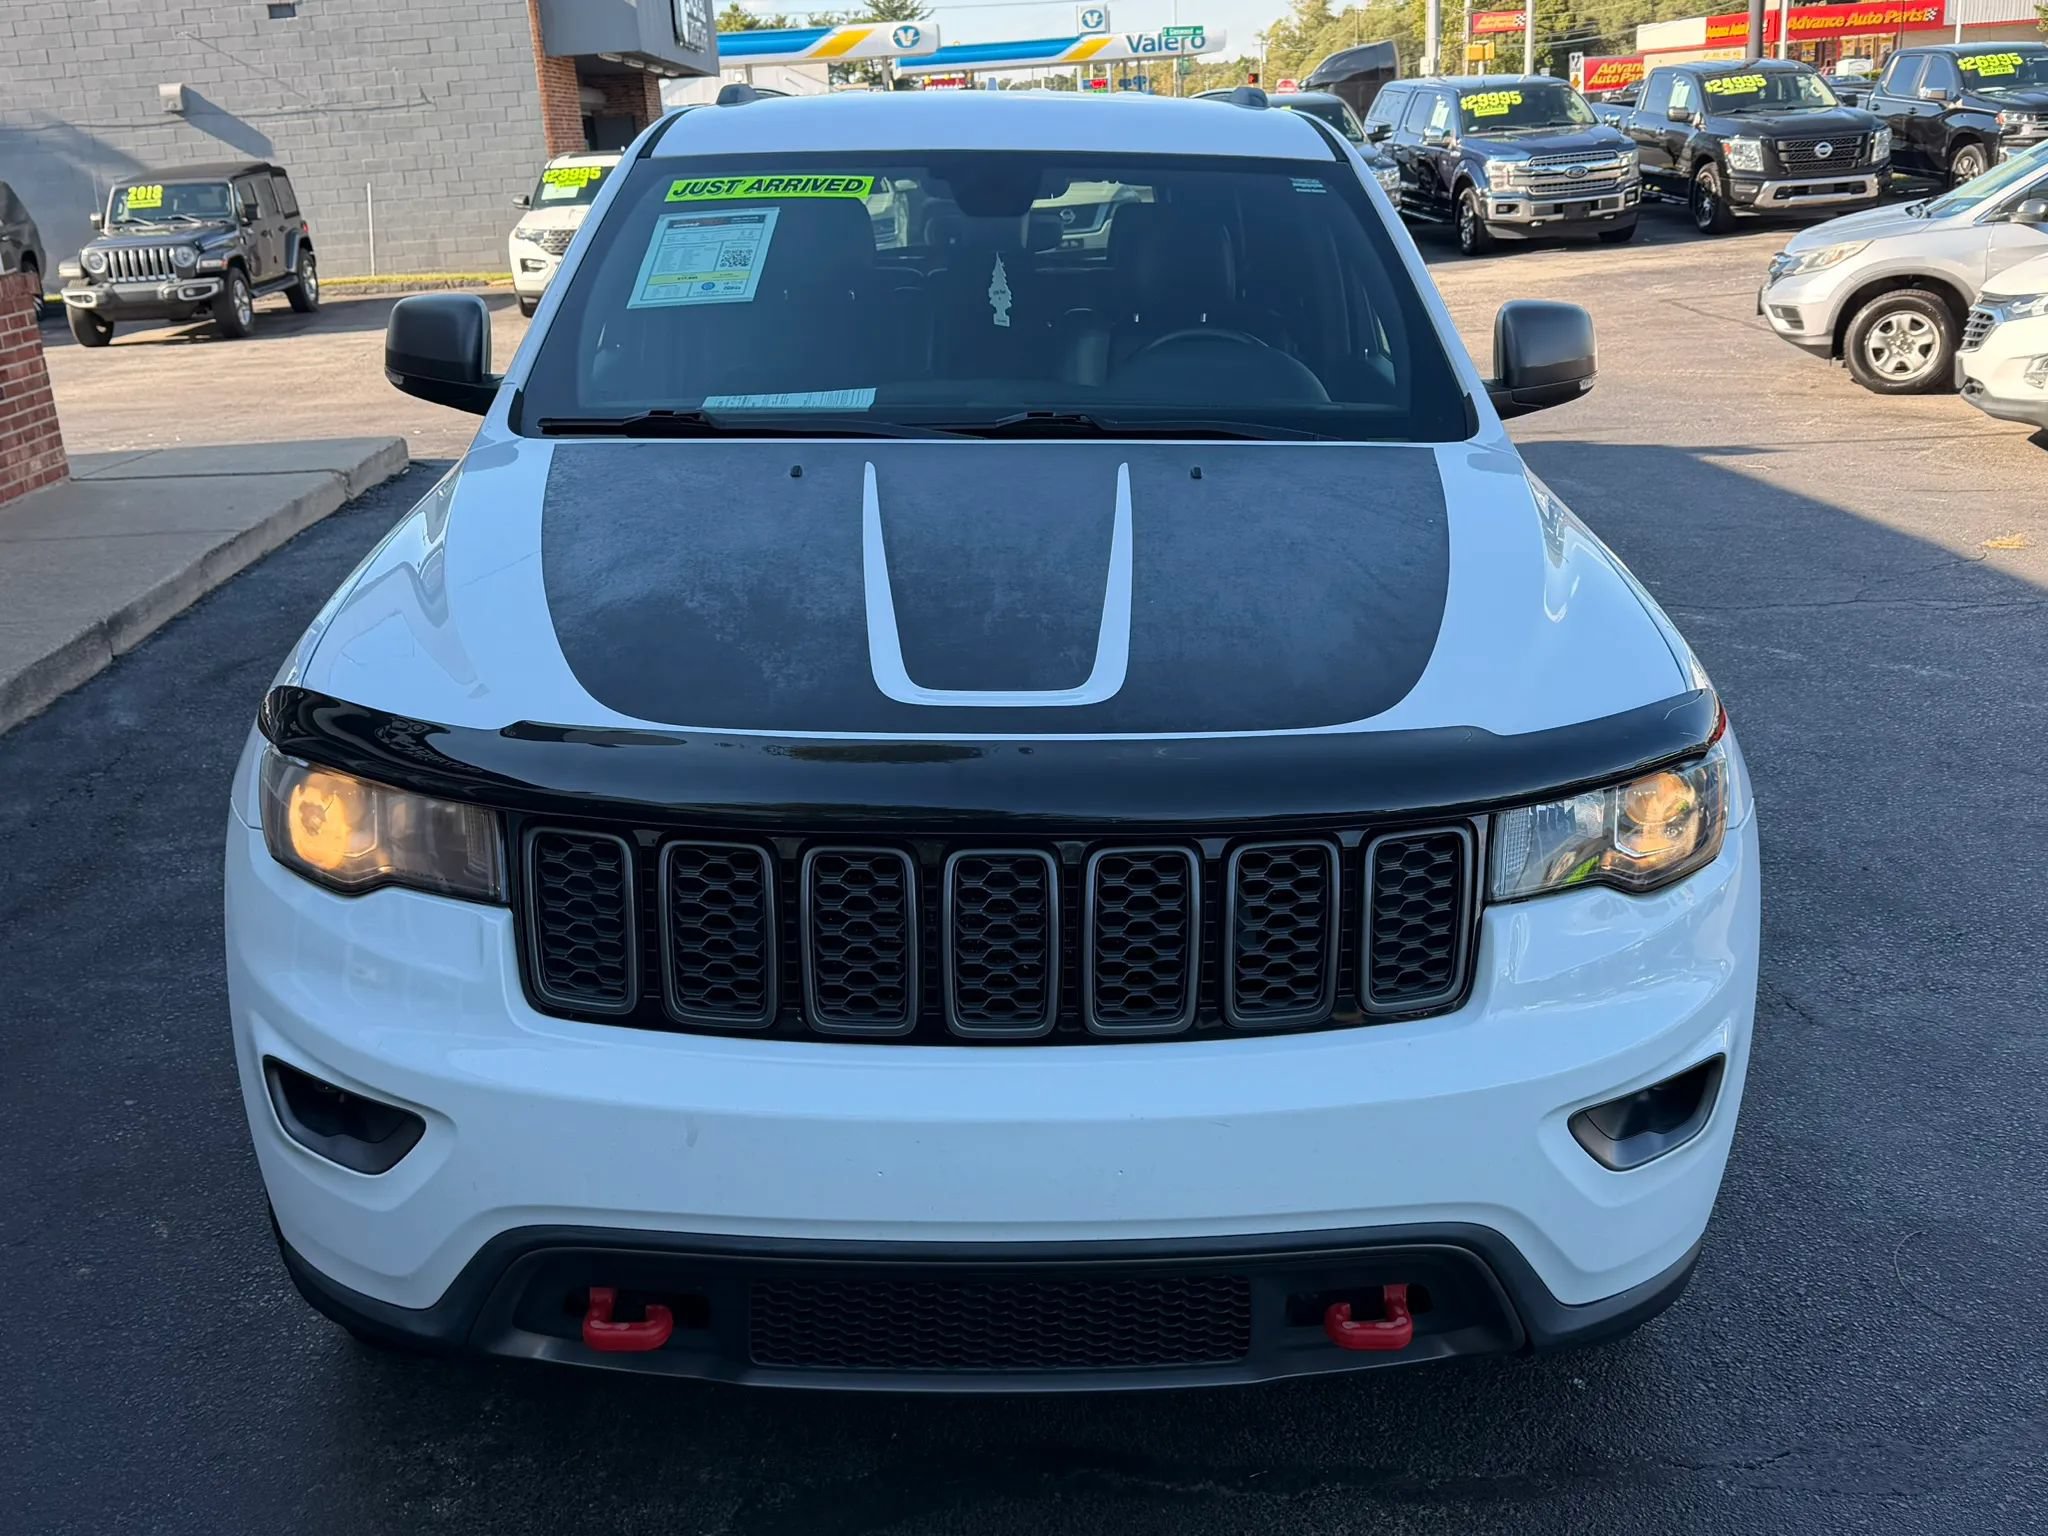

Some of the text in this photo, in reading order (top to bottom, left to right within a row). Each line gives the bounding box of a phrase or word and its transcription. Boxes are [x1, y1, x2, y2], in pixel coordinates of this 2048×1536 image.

[1788, 15, 1845, 30] Advance
[1845, 12, 1882, 27] Auto
[1126, 32, 1206, 53] Valero
[1957, 52, 2023, 71] $26995
[1587, 74, 1620, 86] Auto
[1704, 74, 1768, 93] $24995
[1460, 90, 1522, 110] $29995
[127, 184, 164, 200] 2018
[672, 178, 867, 196] JUST ARRIVED
